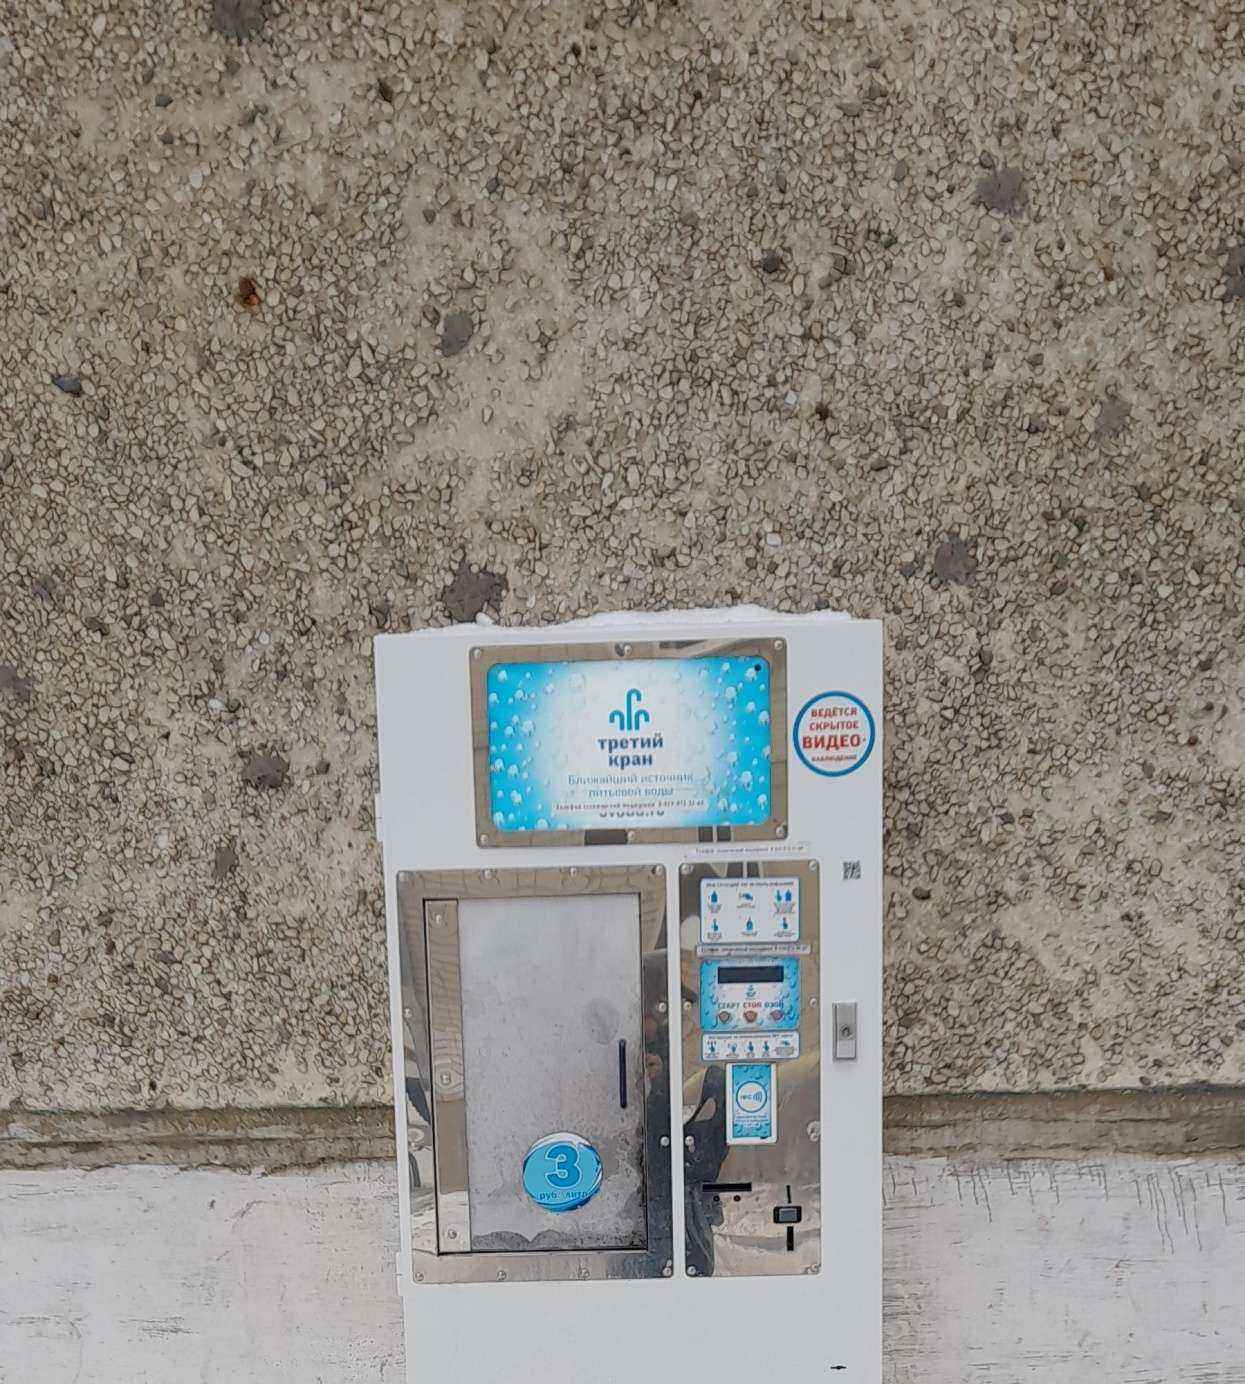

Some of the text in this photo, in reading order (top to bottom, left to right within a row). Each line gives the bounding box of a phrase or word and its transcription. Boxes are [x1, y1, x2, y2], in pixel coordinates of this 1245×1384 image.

[811, 706, 858, 718] ВЕДЁТСЯ
[809, 720, 860, 731] СКРЫТОЕ
[597, 732, 664, 753] третий
[608, 754, 653, 770] кран
[567, 773, 694, 786] Ближайший источник
[546, 1143, 582, 1189] 3
